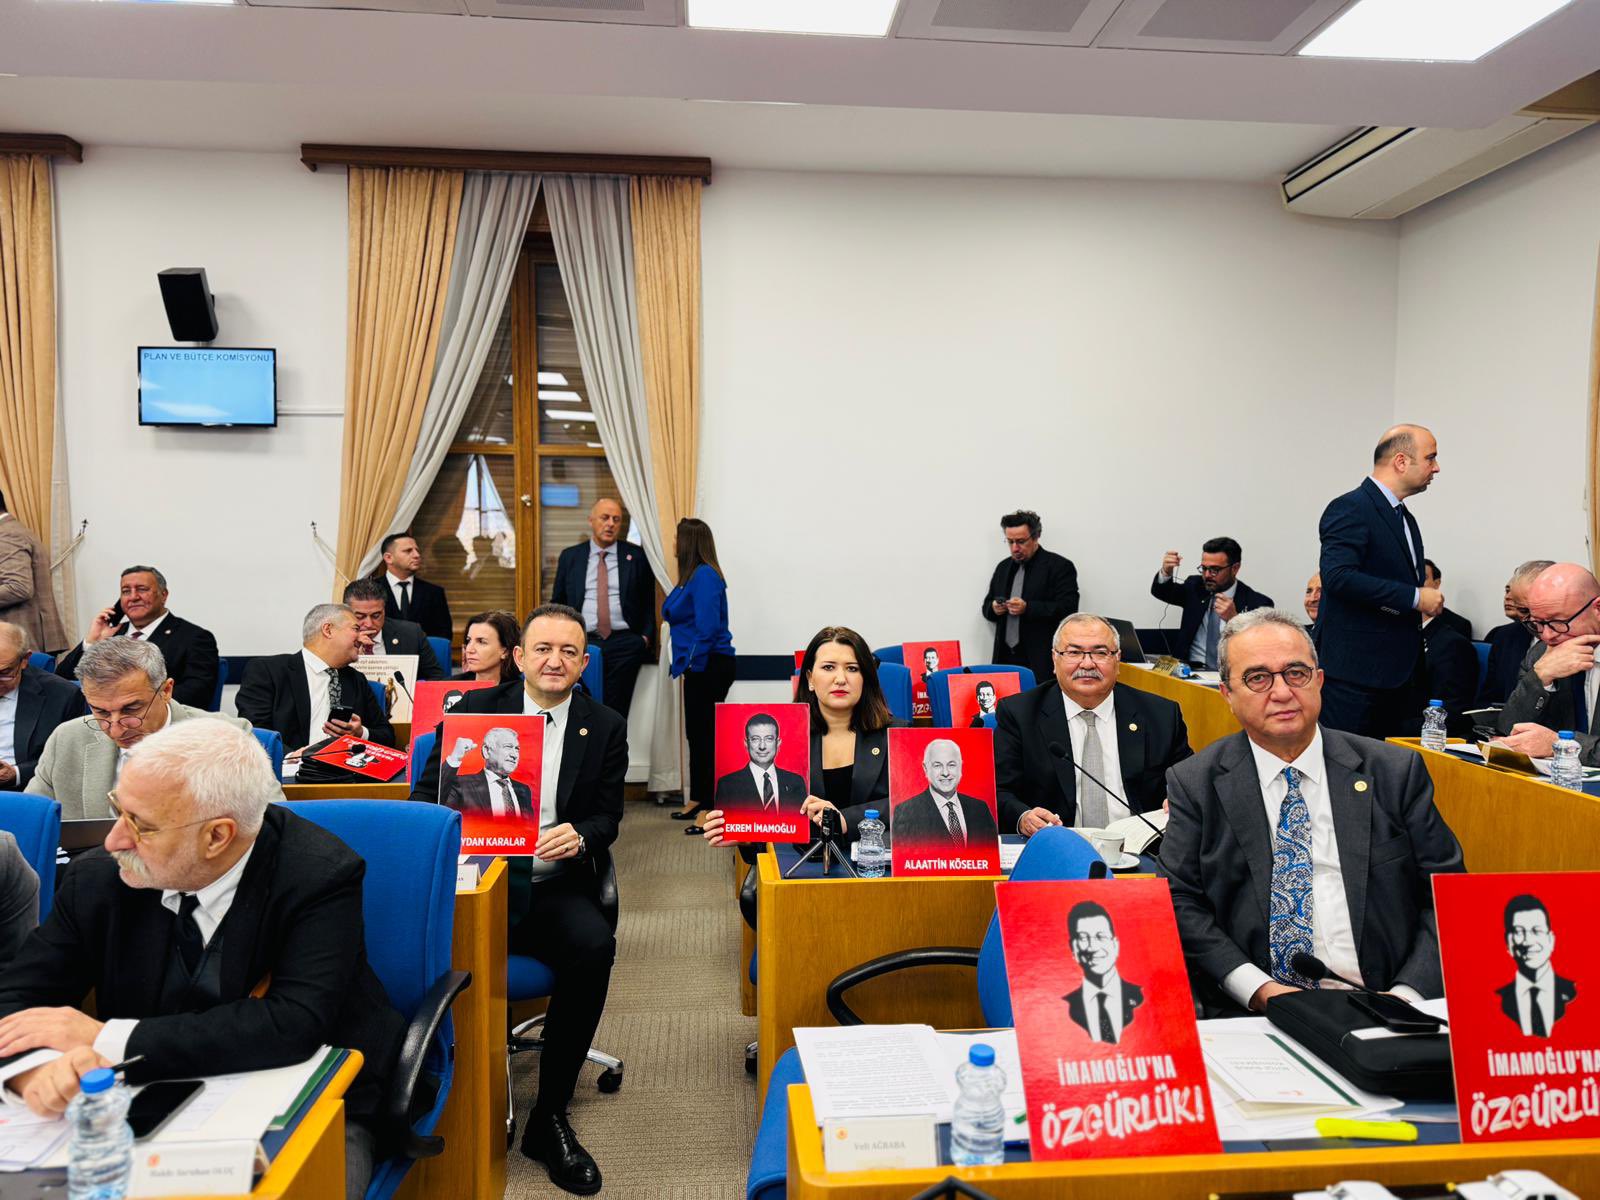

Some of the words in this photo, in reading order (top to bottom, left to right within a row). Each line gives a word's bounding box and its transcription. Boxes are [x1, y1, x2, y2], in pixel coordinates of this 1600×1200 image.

[143, 352, 168, 361] PLAN
[170, 353, 182, 361] VE
[184, 352, 214, 362] BÜTÇE
[216, 352, 270, 362] KOMİSYONU
[725, 823, 752, 833] EKREM
[753, 821, 797, 834] İMAMOĞLU
[461, 837, 485, 847] YDAN
[486, 837, 526, 847] KARALAR
[904, 857, 948, 870] ALAATTİN
[949, 857, 989, 870] KÖSELER
[1057, 1053, 1178, 1087] İMAMOĞLU'NA
[1470, 1076, 1600, 1136] ÖZGÜRLÜ
[1041, 1082, 1206, 1149] ÖZGÜRLÜK!
